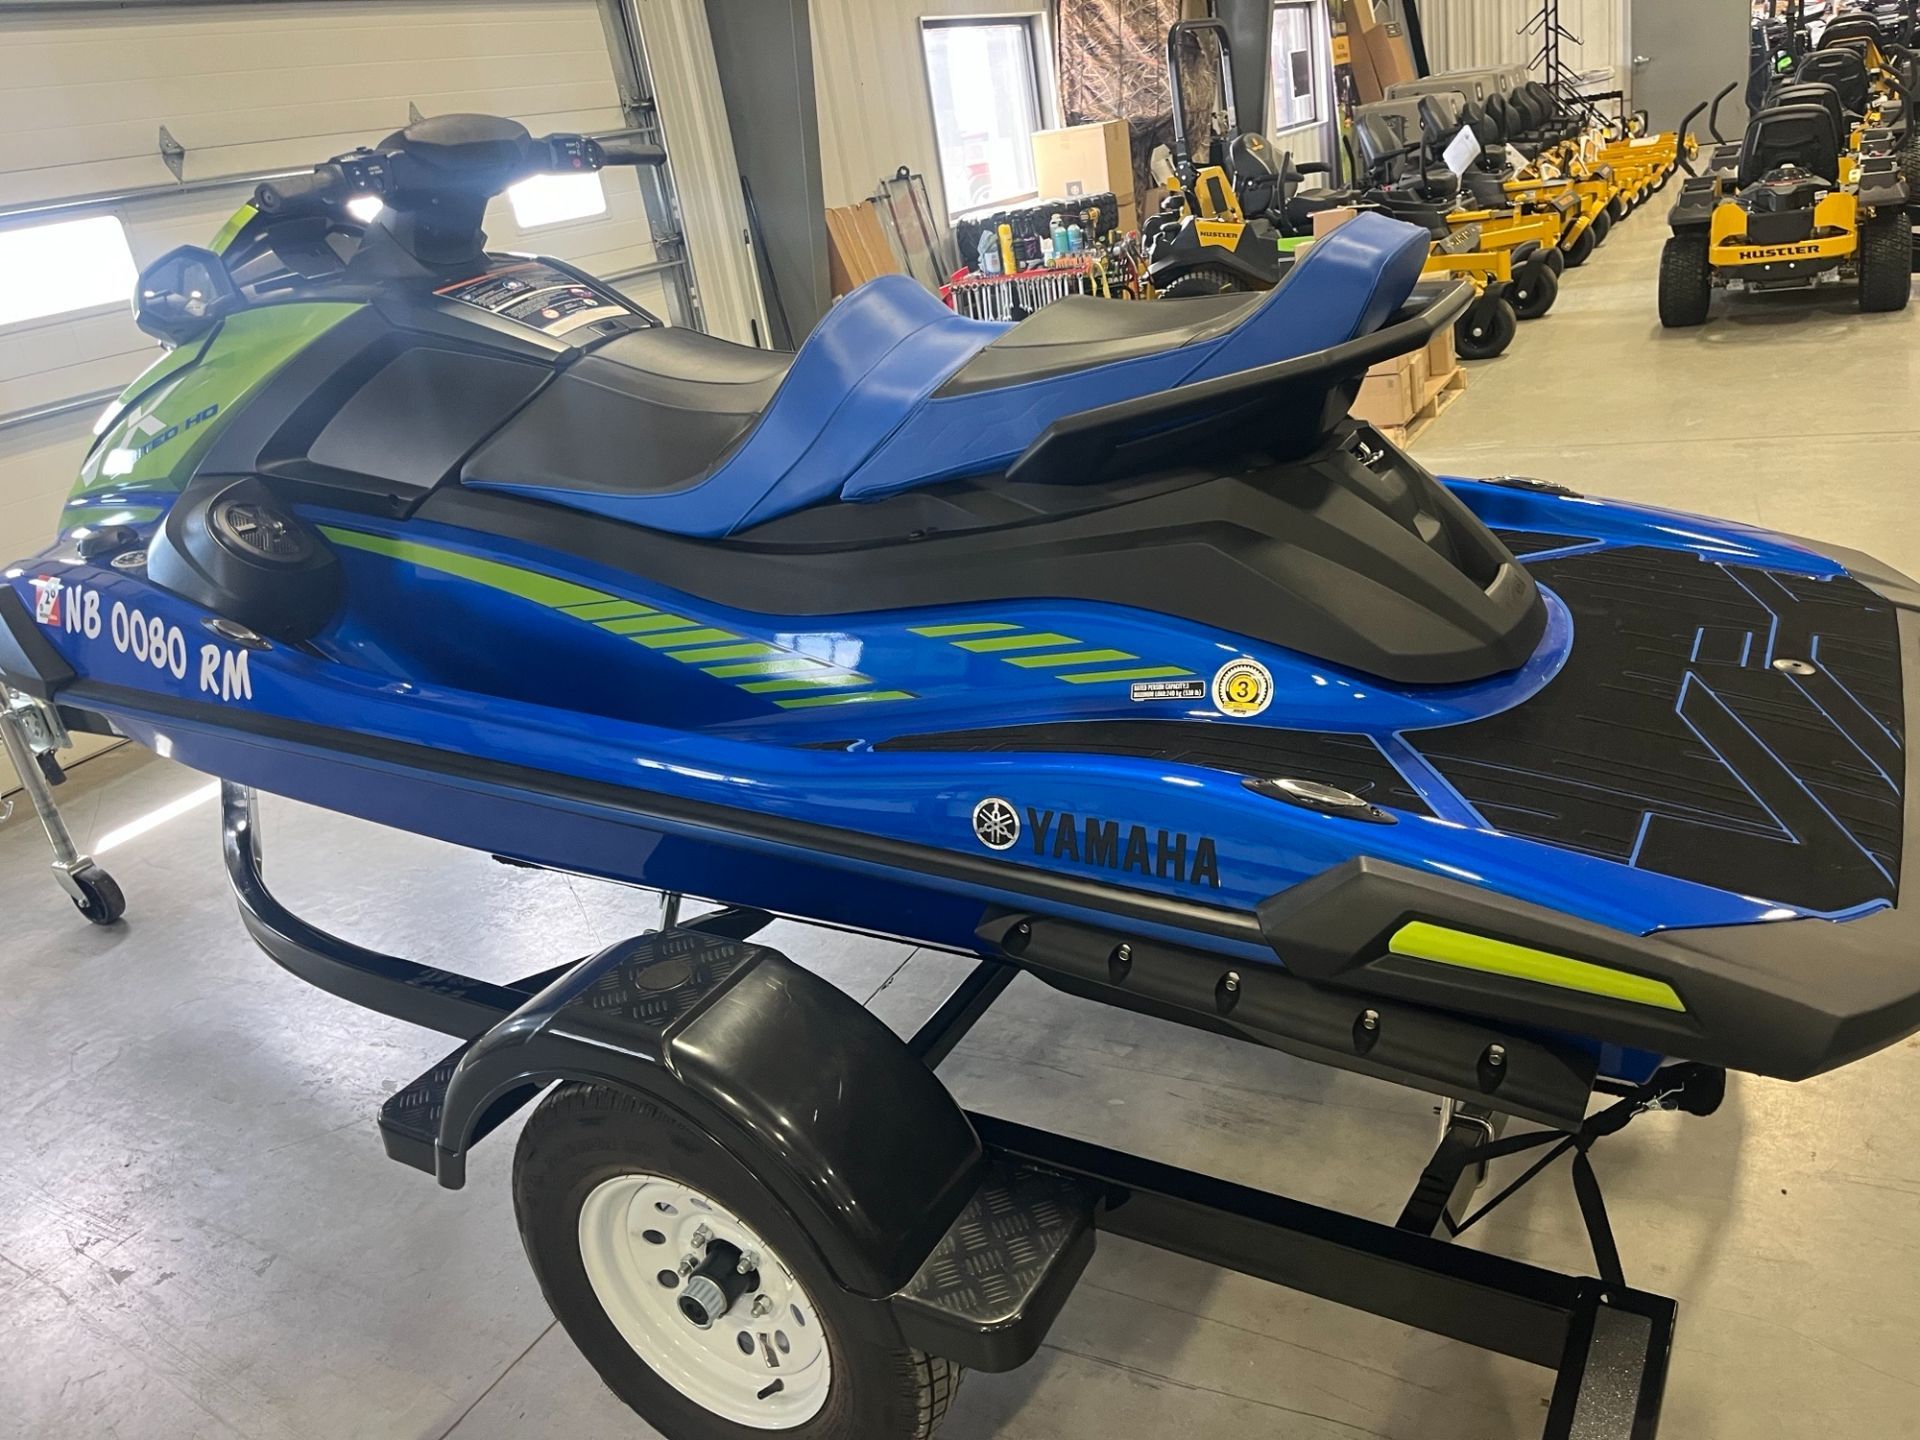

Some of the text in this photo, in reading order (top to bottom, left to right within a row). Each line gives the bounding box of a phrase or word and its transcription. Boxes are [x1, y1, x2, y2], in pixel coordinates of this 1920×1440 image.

[1200, 231, 1238, 239] HUSTLER
[1739, 246, 1819, 259] HUSTLER
[66, 584, 253, 702] NB 0080 RM
[1236, 681, 1249, 698] 3
[1026, 807, 1221, 889] YAMAHA
